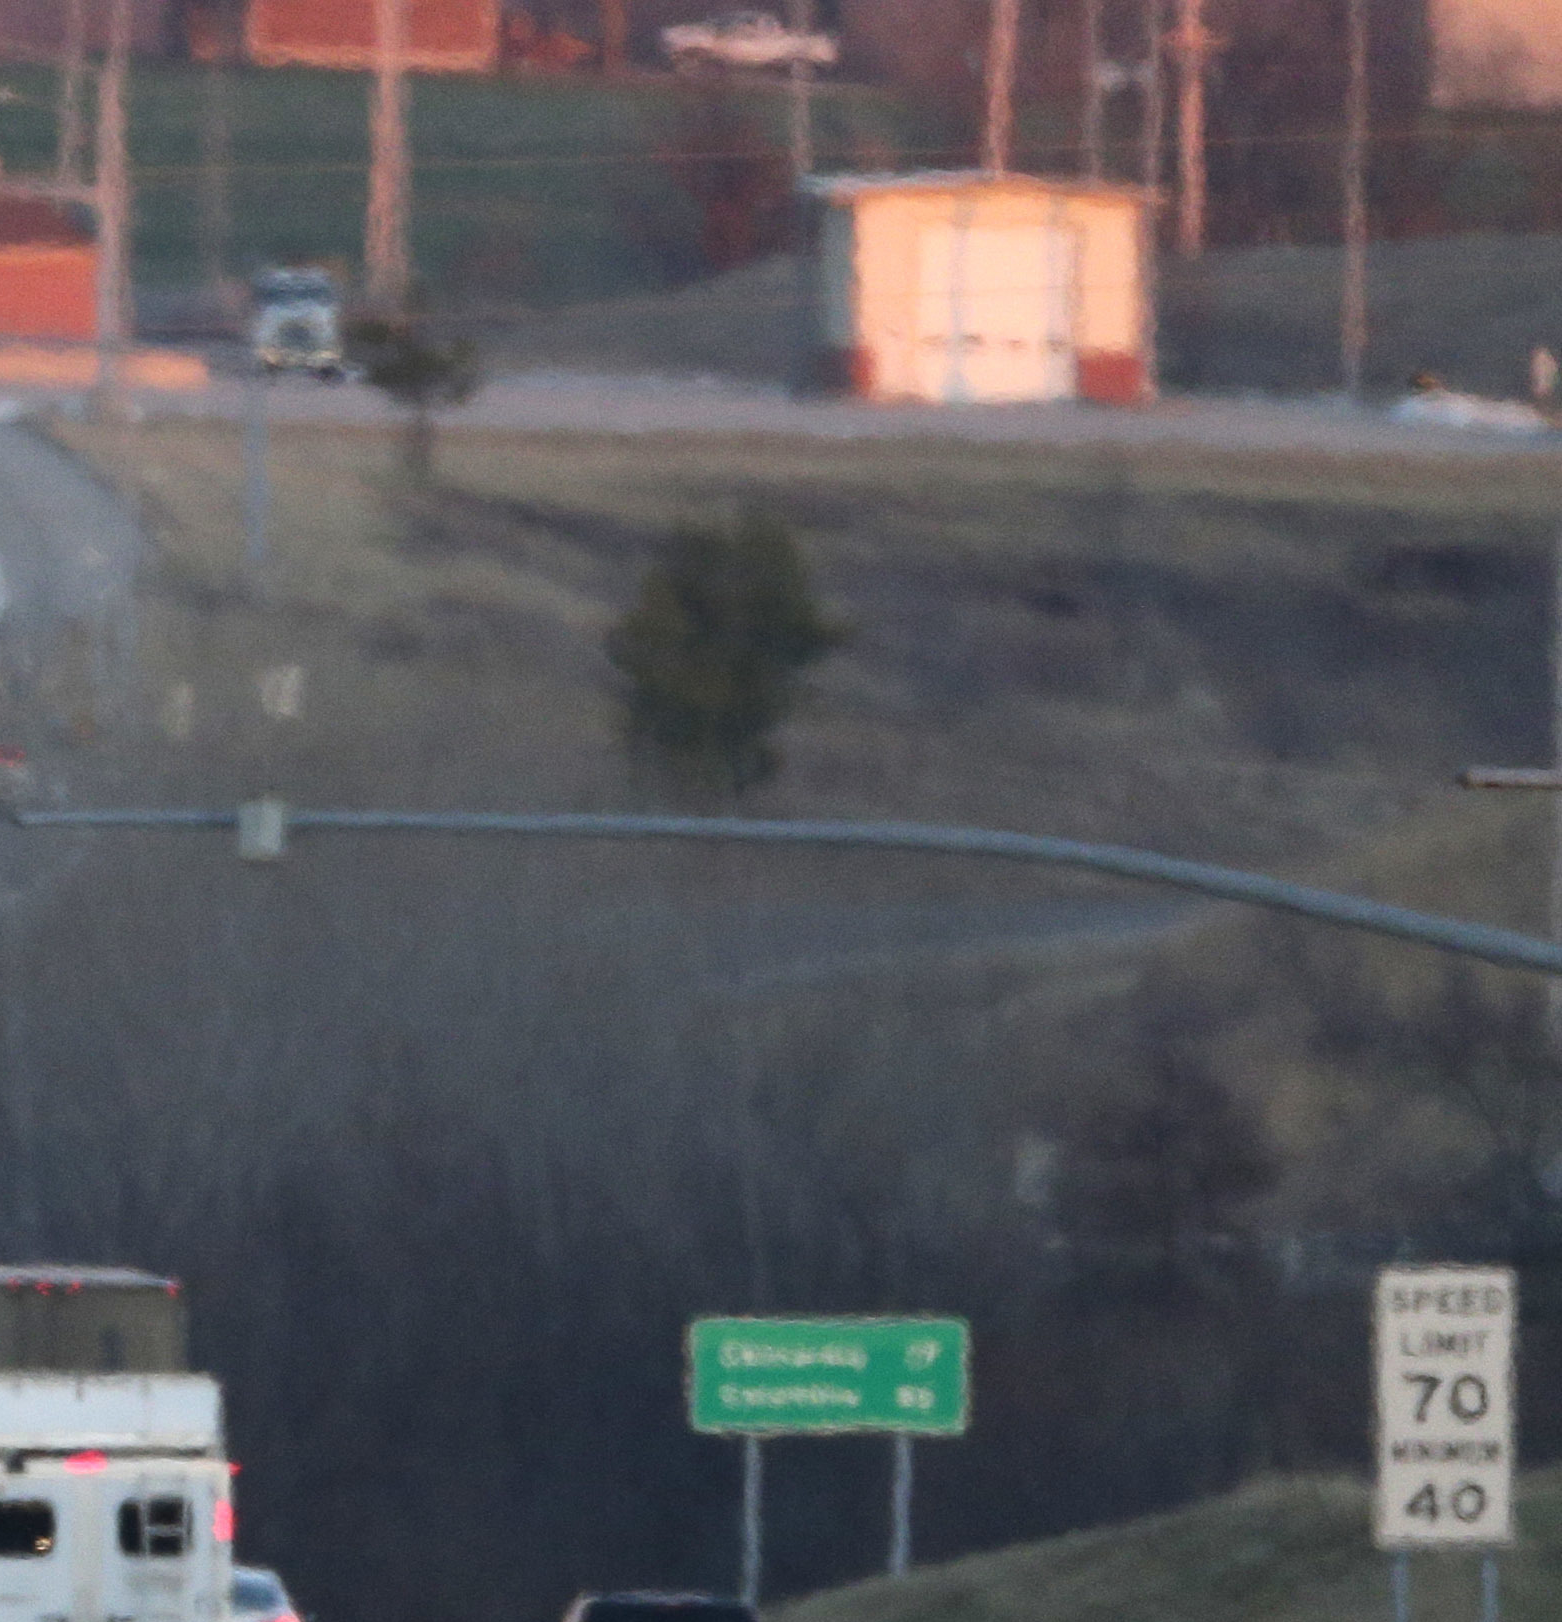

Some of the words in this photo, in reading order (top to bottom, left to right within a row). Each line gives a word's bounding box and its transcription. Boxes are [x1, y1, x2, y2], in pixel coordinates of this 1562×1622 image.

[1392, 1285, 1504, 1315] SPEED
[1400, 1330, 1488, 1357] LIMIT
[1401, 1372, 1488, 1424] 70
[1405, 1482, 1487, 1522] 40
